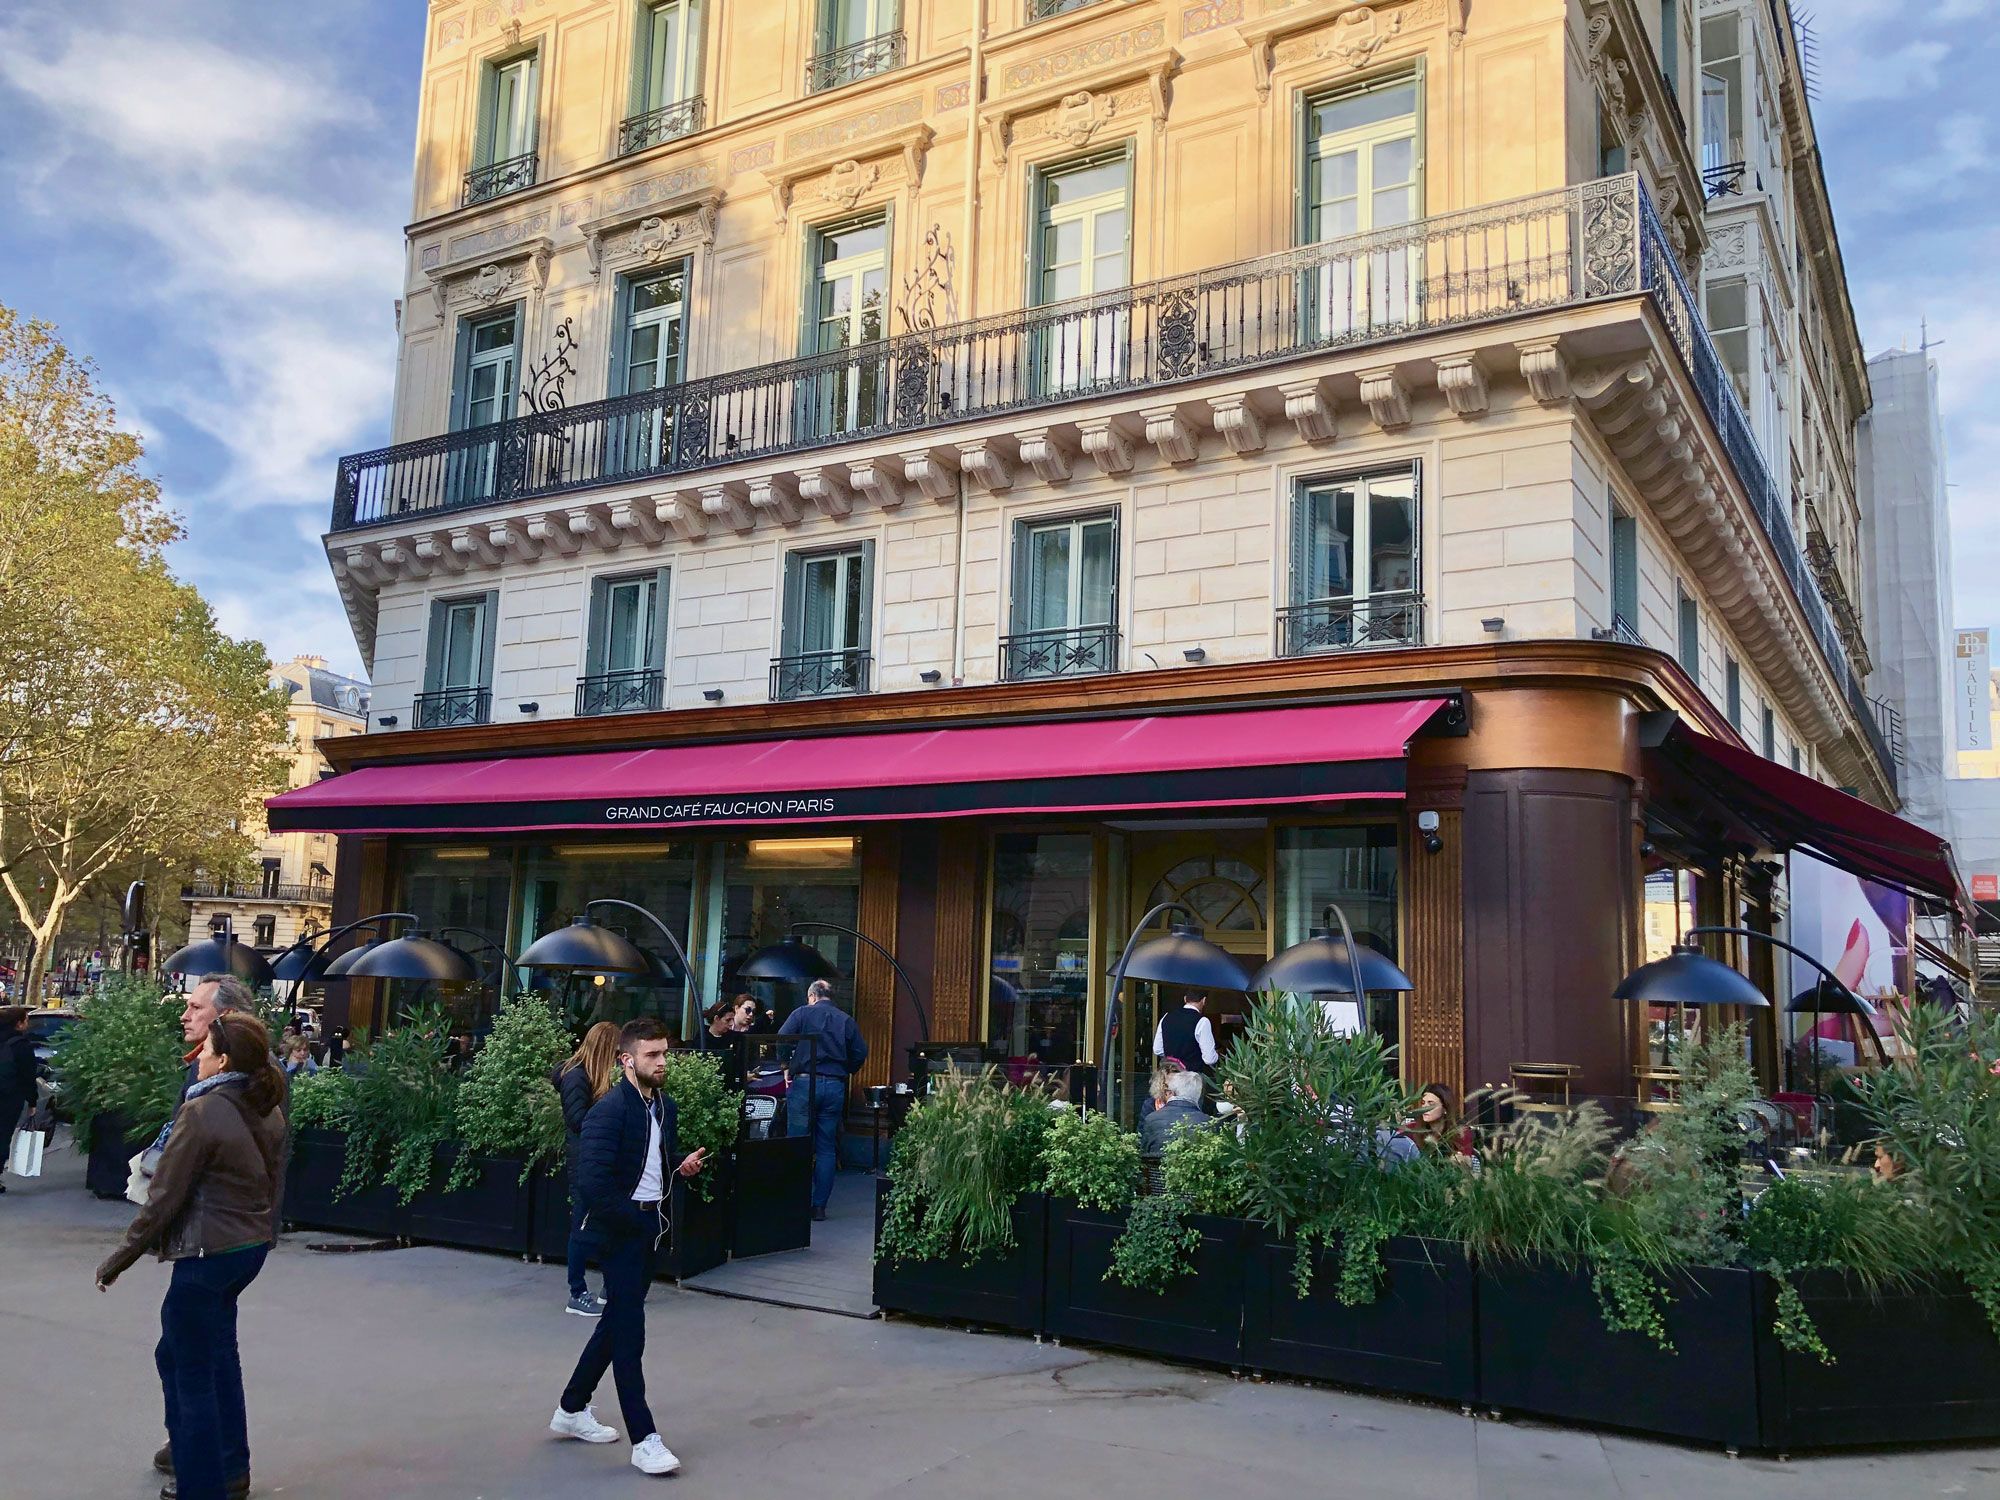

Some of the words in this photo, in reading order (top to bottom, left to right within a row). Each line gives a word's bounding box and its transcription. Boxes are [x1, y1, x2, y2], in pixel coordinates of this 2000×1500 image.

[605, 806, 661, 820] GRAND
[663, 802, 702, 818] CAFÉ
[703, 801, 783, 816] FAUCHON
[786, 798, 834, 813] PARIS
